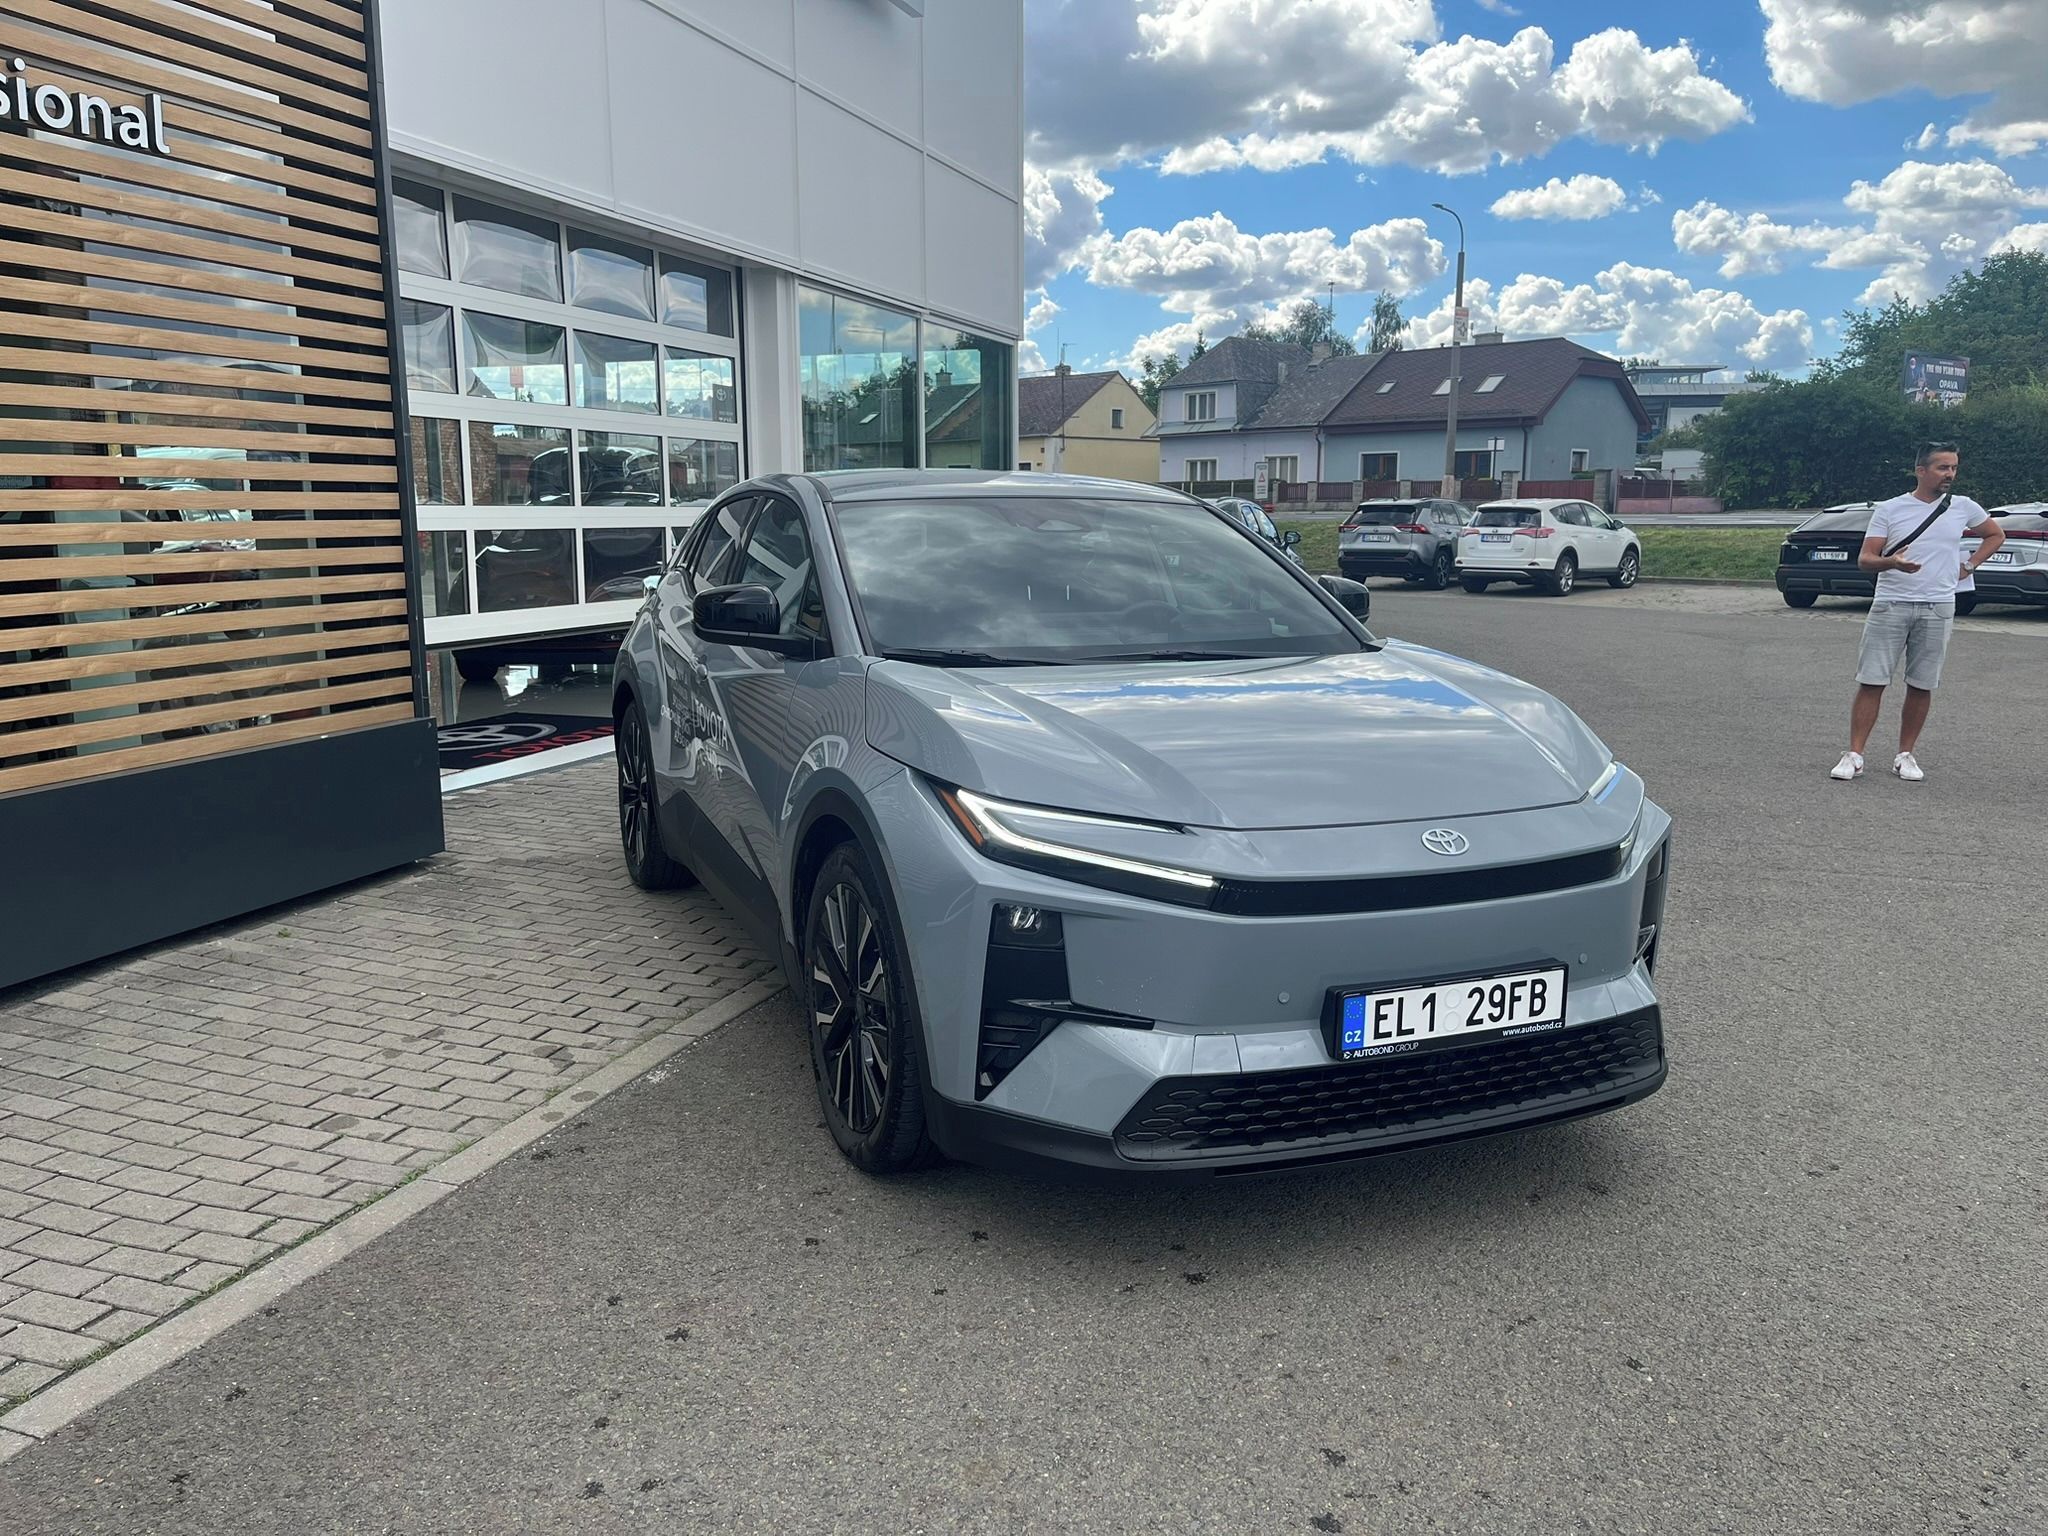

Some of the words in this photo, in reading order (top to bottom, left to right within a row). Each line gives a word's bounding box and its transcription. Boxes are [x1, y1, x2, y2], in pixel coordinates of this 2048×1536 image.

[694, 698, 728, 752] TOYOTA
[1373, 992, 1436, 1041] EL1
[1465, 978, 1548, 1027] 29FB
[1344, 1029, 1361, 1043] CZ
[1502, 1020, 1563, 1037] www.autobond.cz
[1352, 1045, 1395, 1058] AUTOBOND
[1394, 1041, 1419, 1053] GROUP
